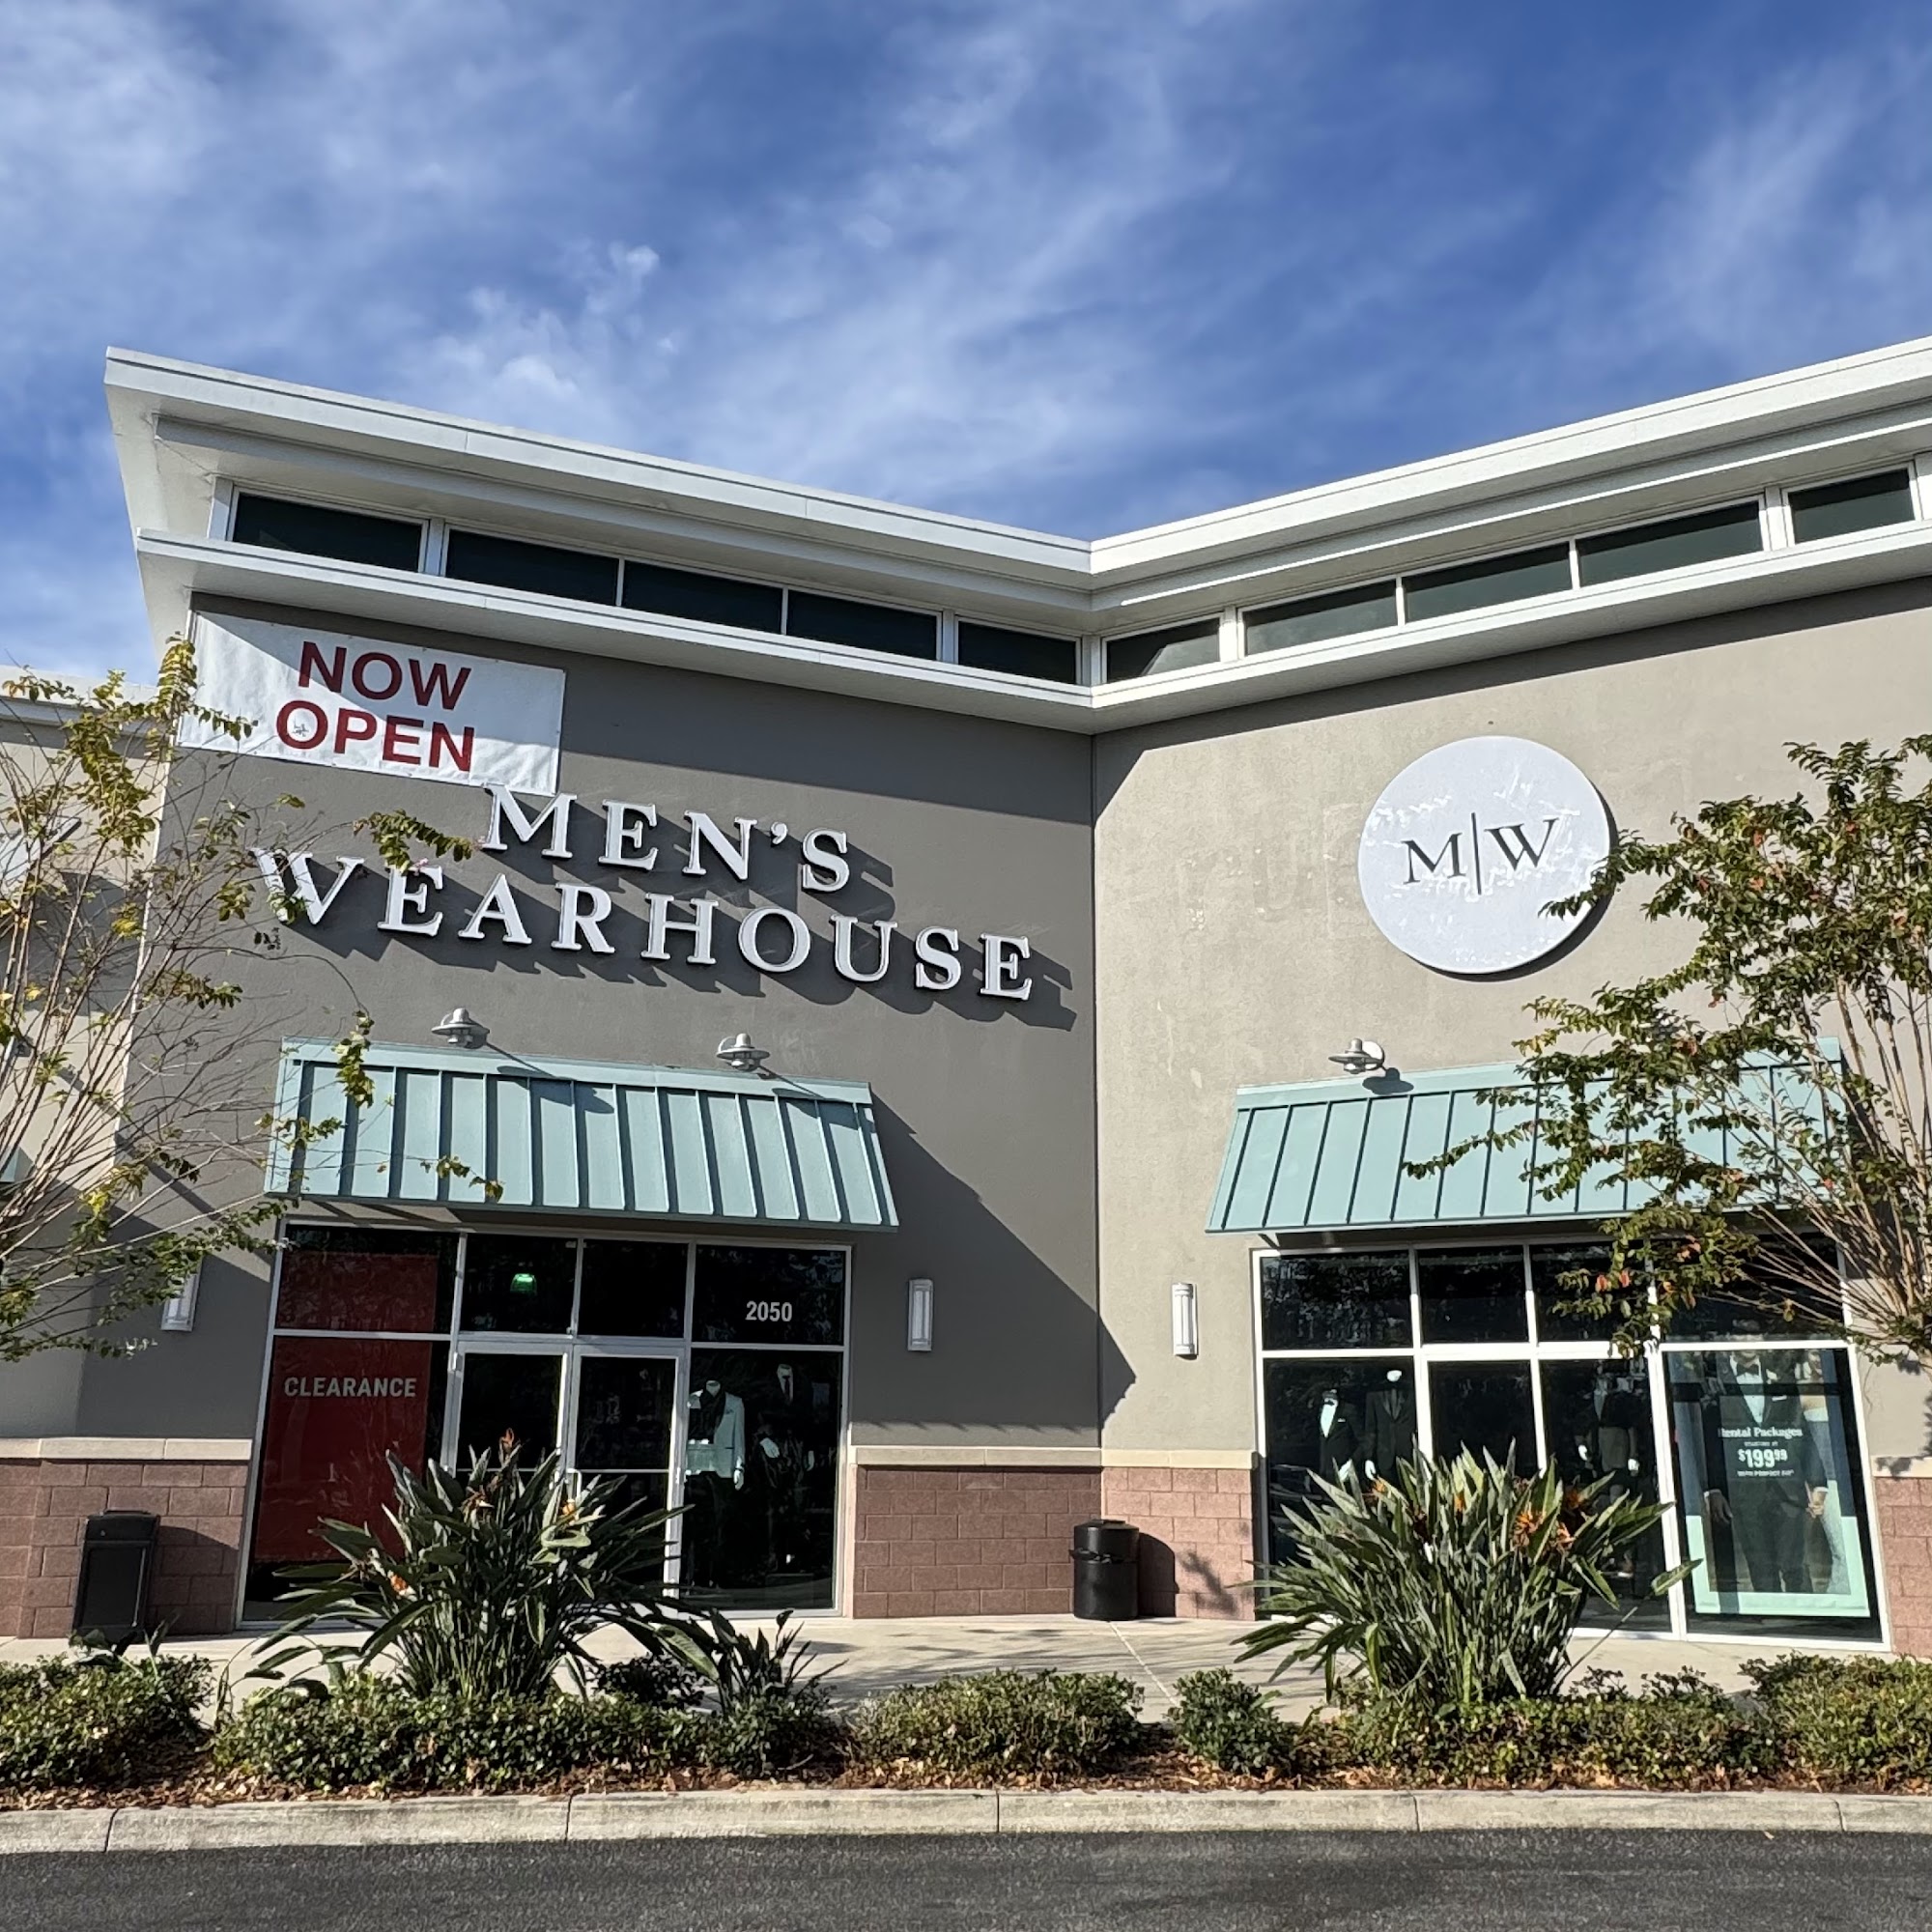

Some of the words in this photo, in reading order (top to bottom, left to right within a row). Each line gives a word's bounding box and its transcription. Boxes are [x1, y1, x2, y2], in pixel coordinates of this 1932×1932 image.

[298, 641, 471, 710] NOW
[276, 700, 474, 772] OPEN
[480, 783, 850, 893] MEN'S
[248, 847, 1033, 1001] WEARHOUSE
[745, 1300, 792, 1322] 2050
[284, 1377, 417, 1398] CLEARANCE
[1753, 1426, 1804, 1440] Packages
